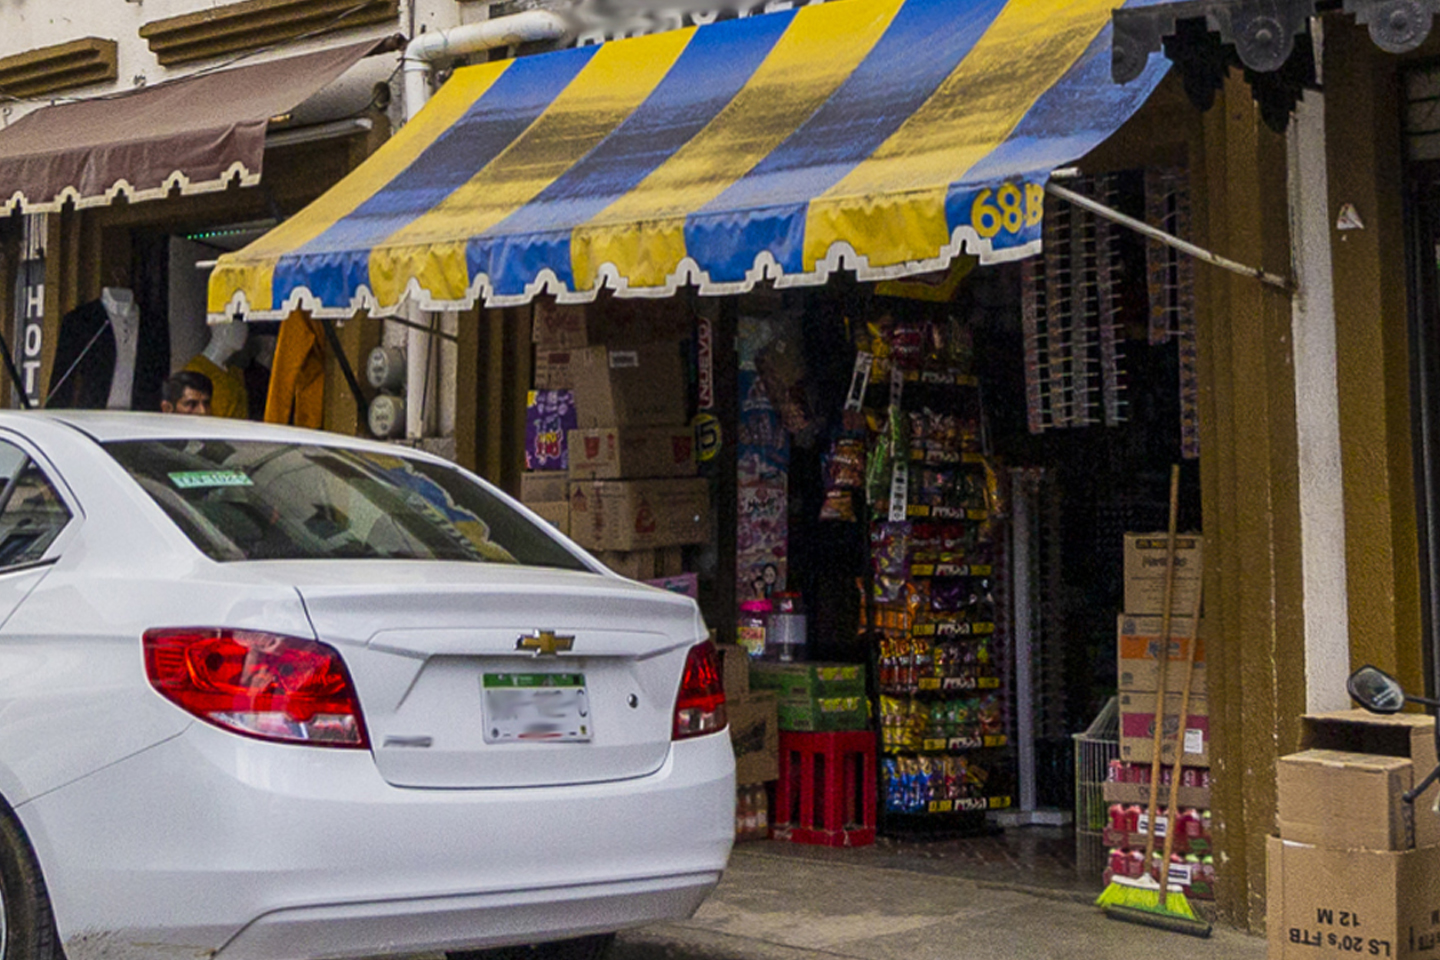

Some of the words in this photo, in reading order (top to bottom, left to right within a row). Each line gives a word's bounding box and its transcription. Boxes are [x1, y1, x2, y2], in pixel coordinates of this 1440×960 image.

[23, 284, 45, 406] HOT
[1316, 908, 1334, 925] M
[1339, 911, 1361, 928] 12
[1288, 927, 1322, 947] FTB
[1327, 932, 1363, 952] 20's
[1368, 938, 1391, 957] LS
